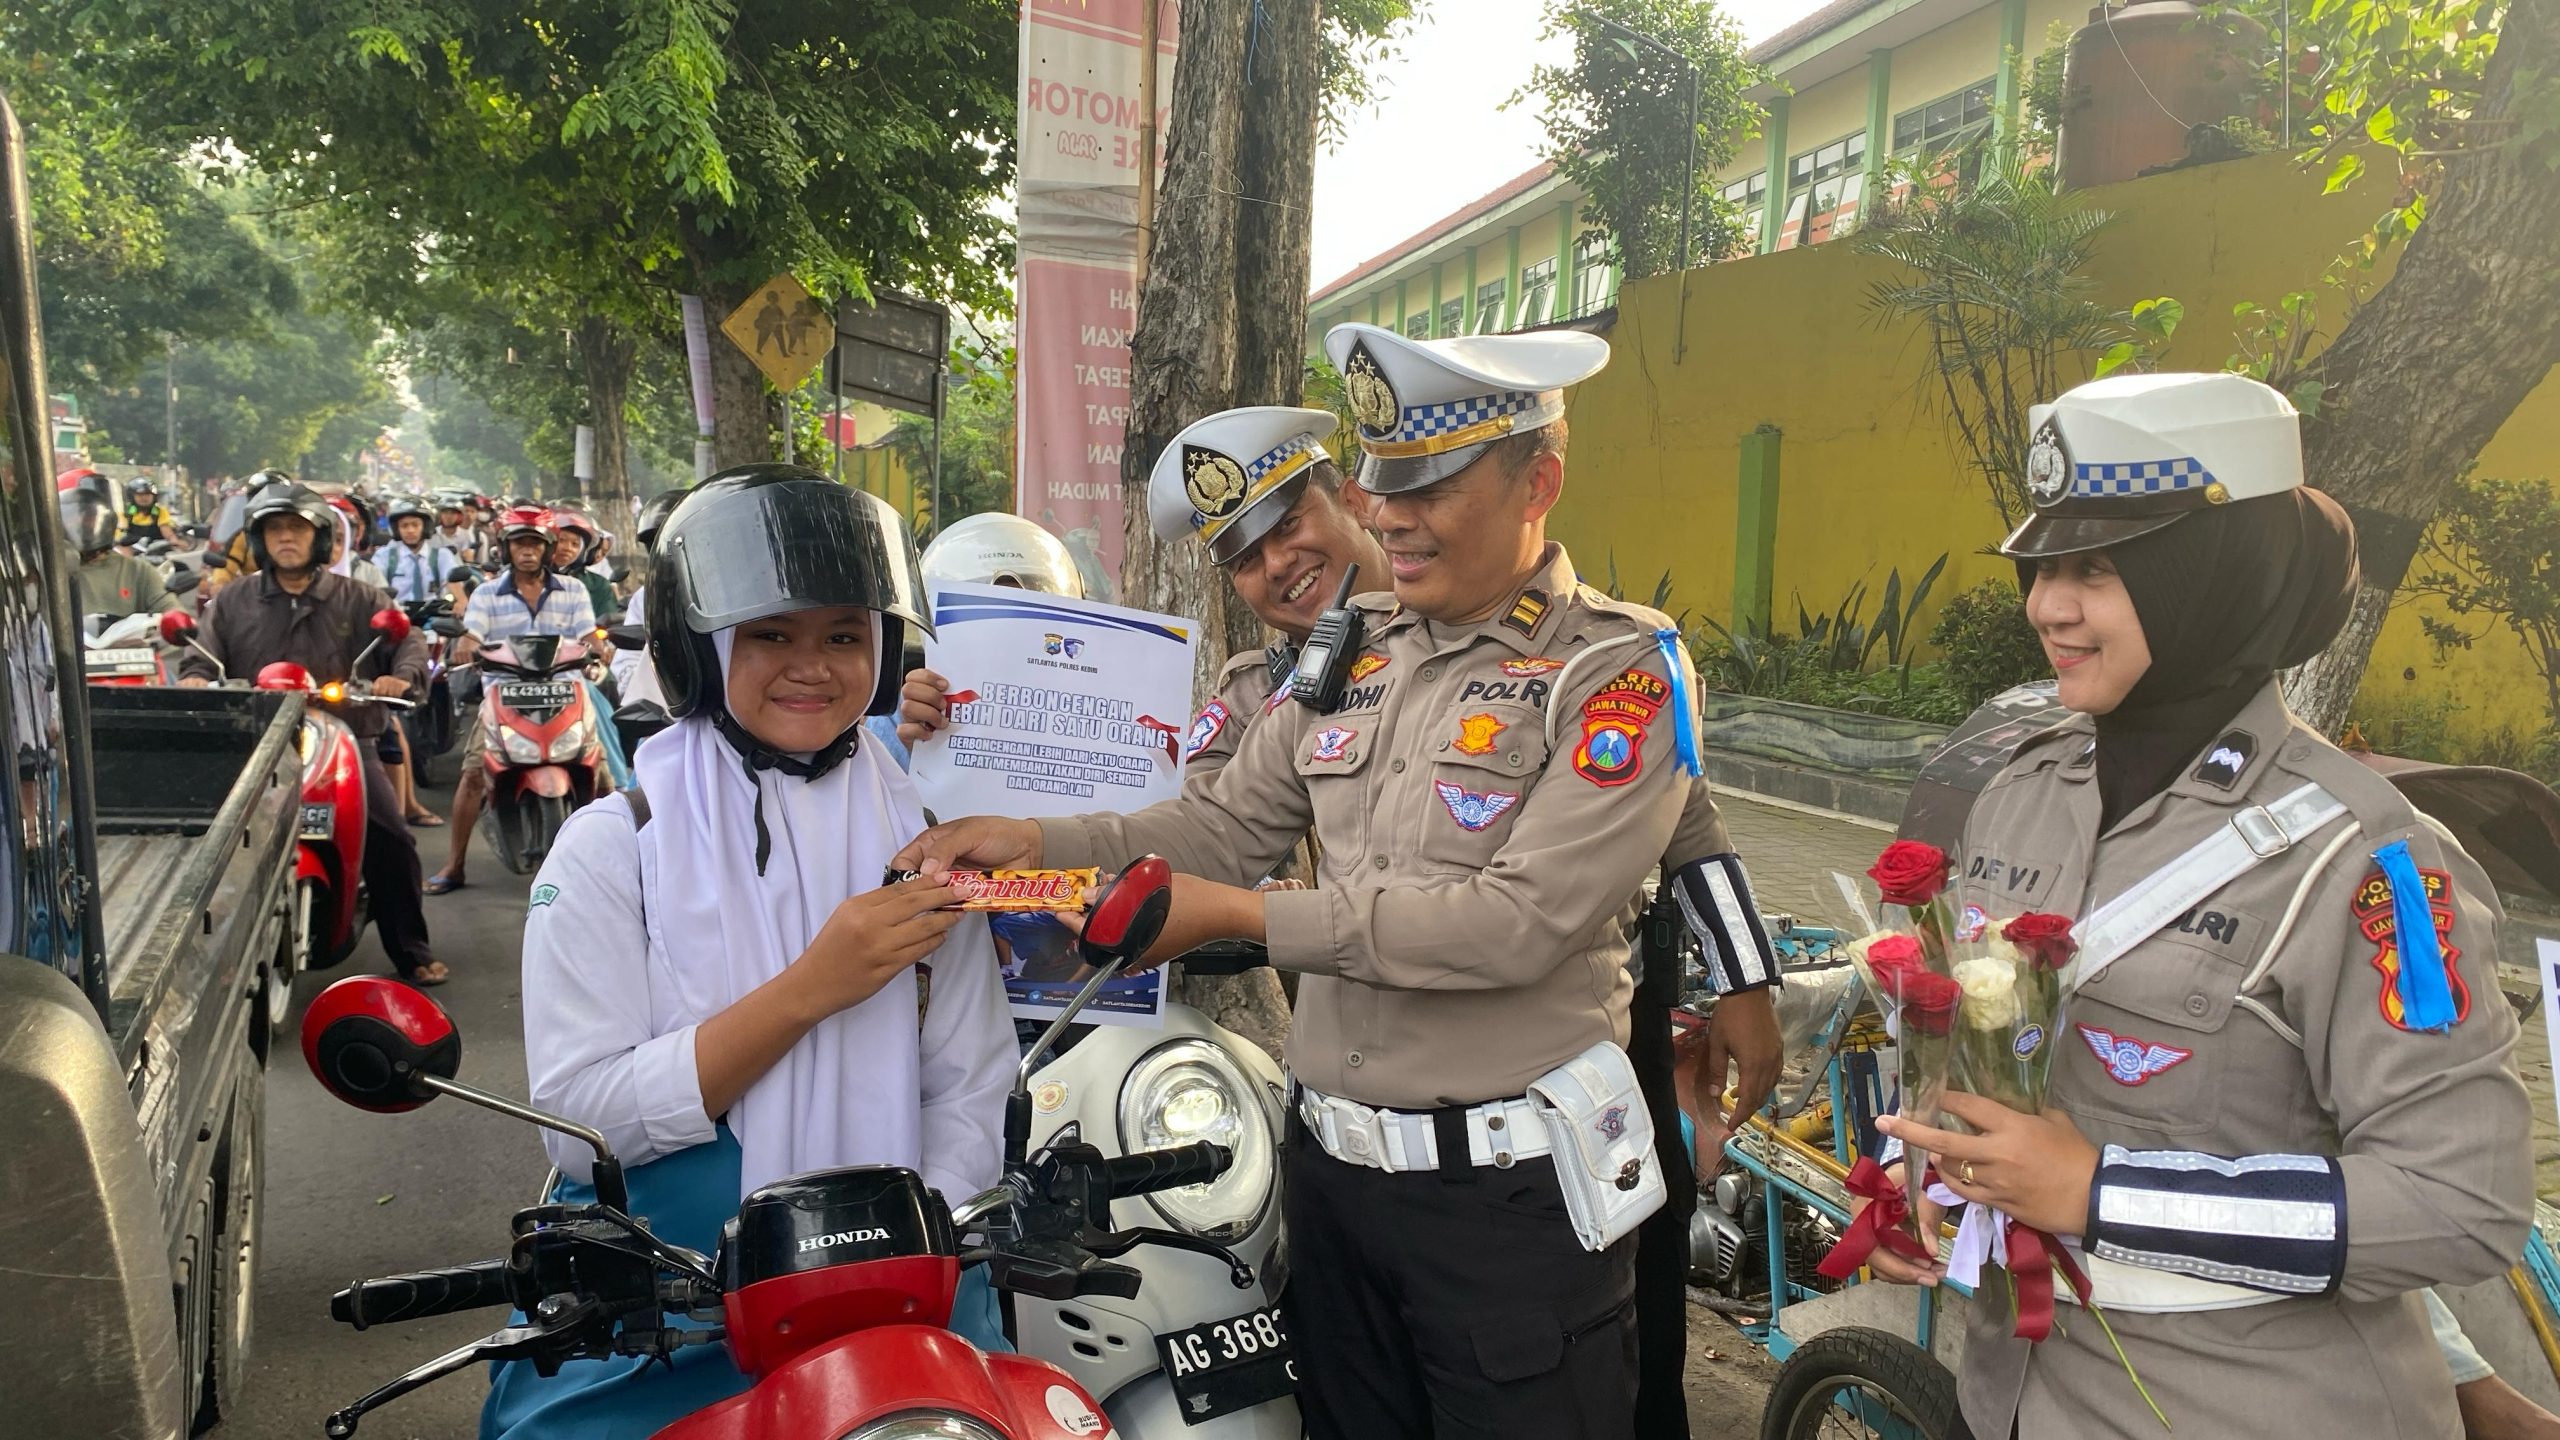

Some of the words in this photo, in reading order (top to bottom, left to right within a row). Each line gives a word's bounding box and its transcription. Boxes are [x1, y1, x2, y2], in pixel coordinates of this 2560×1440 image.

[1059, 662, 1080, 672] POLRES
[1615, 672, 1663, 694] LRES
[981, 681, 1134, 723] BERBONCENGAN
[1321, 683, 1387, 716] ADHI
[1460, 678, 1549, 710] POLR
[1600, 682, 1650, 695] KEDIRI
[1589, 700, 1617, 712] JAWA
[1619, 701, 1649, 719] TIMUR
[949, 702, 994, 727] EBIH
[999, 707, 1048, 733] DARI
[1052, 714, 1102, 741] SATU
[1107, 723, 1169, 750] ORANG
[949, 735, 1032, 757] BERBONCENGAN
[1032, 743, 1063, 760] LEBIH
[1064, 747, 1089, 765] DARI
[1090, 751, 1117, 768] SATU
[1117, 755, 1153, 773] ORANG
[955, 753, 992, 771] DAPAT
[991, 756, 1083, 780] MEMBAHAYAKAN
[1083, 765, 1106, 782] DIRI
[1105, 768, 1146, 788] SENDIRI
[1007, 775, 1031, 791] DAN
[1032, 777, 1068, 795] ORANG
[1069, 781, 1095, 798] LAIN
[1968, 855, 2041, 894] DEVI
[797, 1226, 892, 1253] HONDA
[1168, 1333, 1212, 1377] AG
